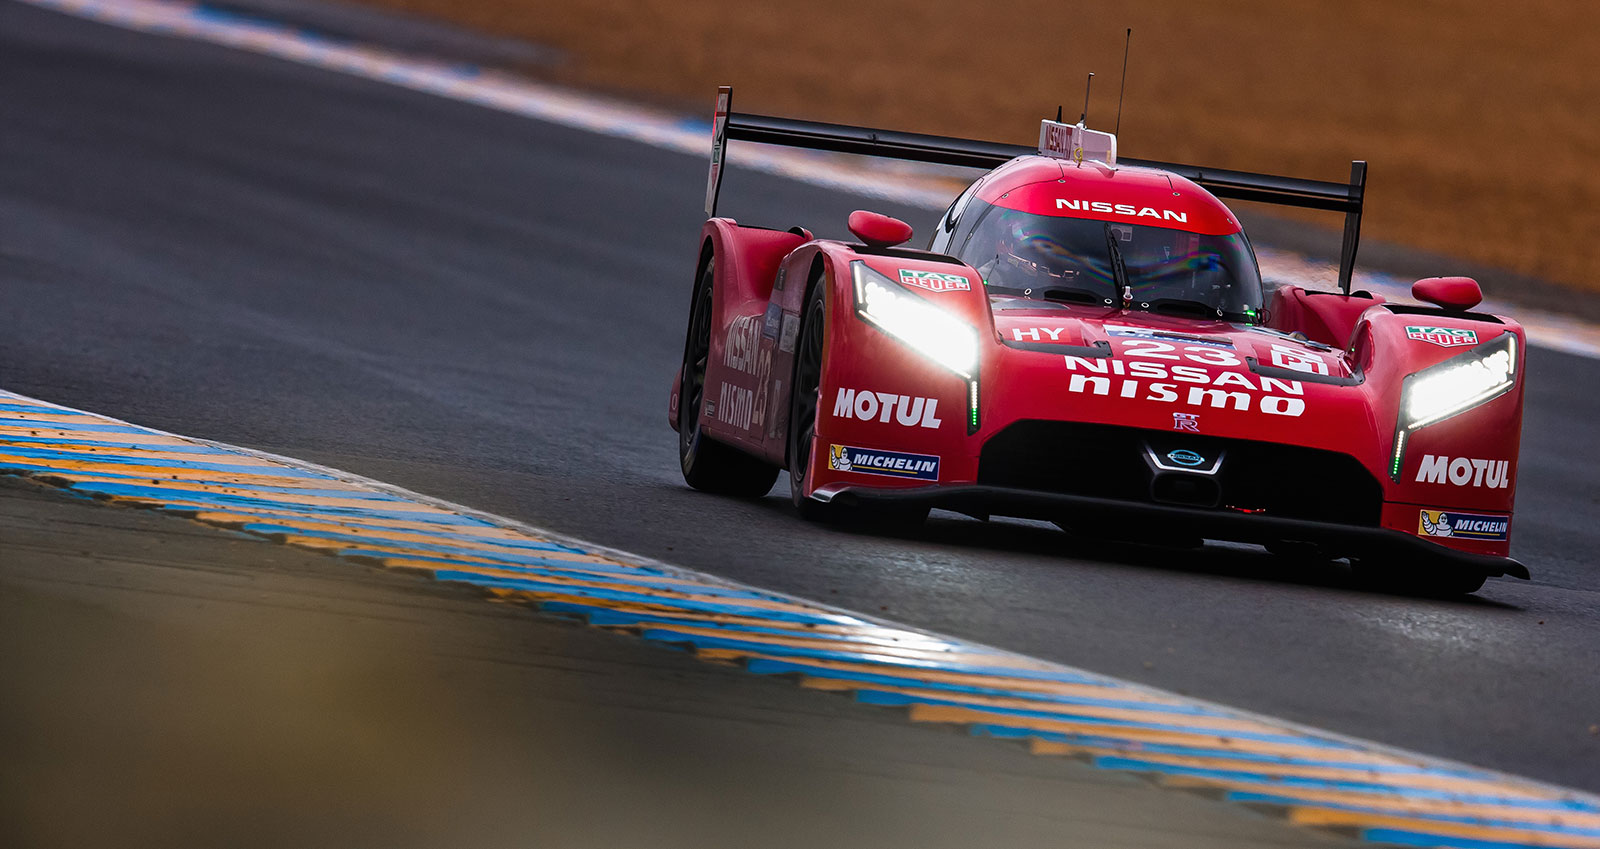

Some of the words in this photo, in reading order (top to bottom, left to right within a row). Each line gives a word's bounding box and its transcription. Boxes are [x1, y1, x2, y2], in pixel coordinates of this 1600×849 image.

[1056, 198, 1187, 223] NISSAN
[904, 270, 964, 283] TAG
[904, 276, 968, 290] HEUER
[1011, 327, 1065, 341] HY
[1411, 326, 1470, 337] TAG
[1411, 332, 1475, 345] HEUER
[723, 314, 761, 377] NISSAN
[1121, 339, 1241, 366] 23
[1064, 355, 1304, 396] NISSAN
[751, 348, 771, 427] 23
[1068, 374, 1306, 417] nismo
[833, 388, 942, 429] MOTUL
[1174, 418, 1200, 432] R
[853, 453, 936, 472] MICHELIN
[1415, 454, 1509, 489] MOTUL
[1454, 519, 1508, 533] MICHELIN
